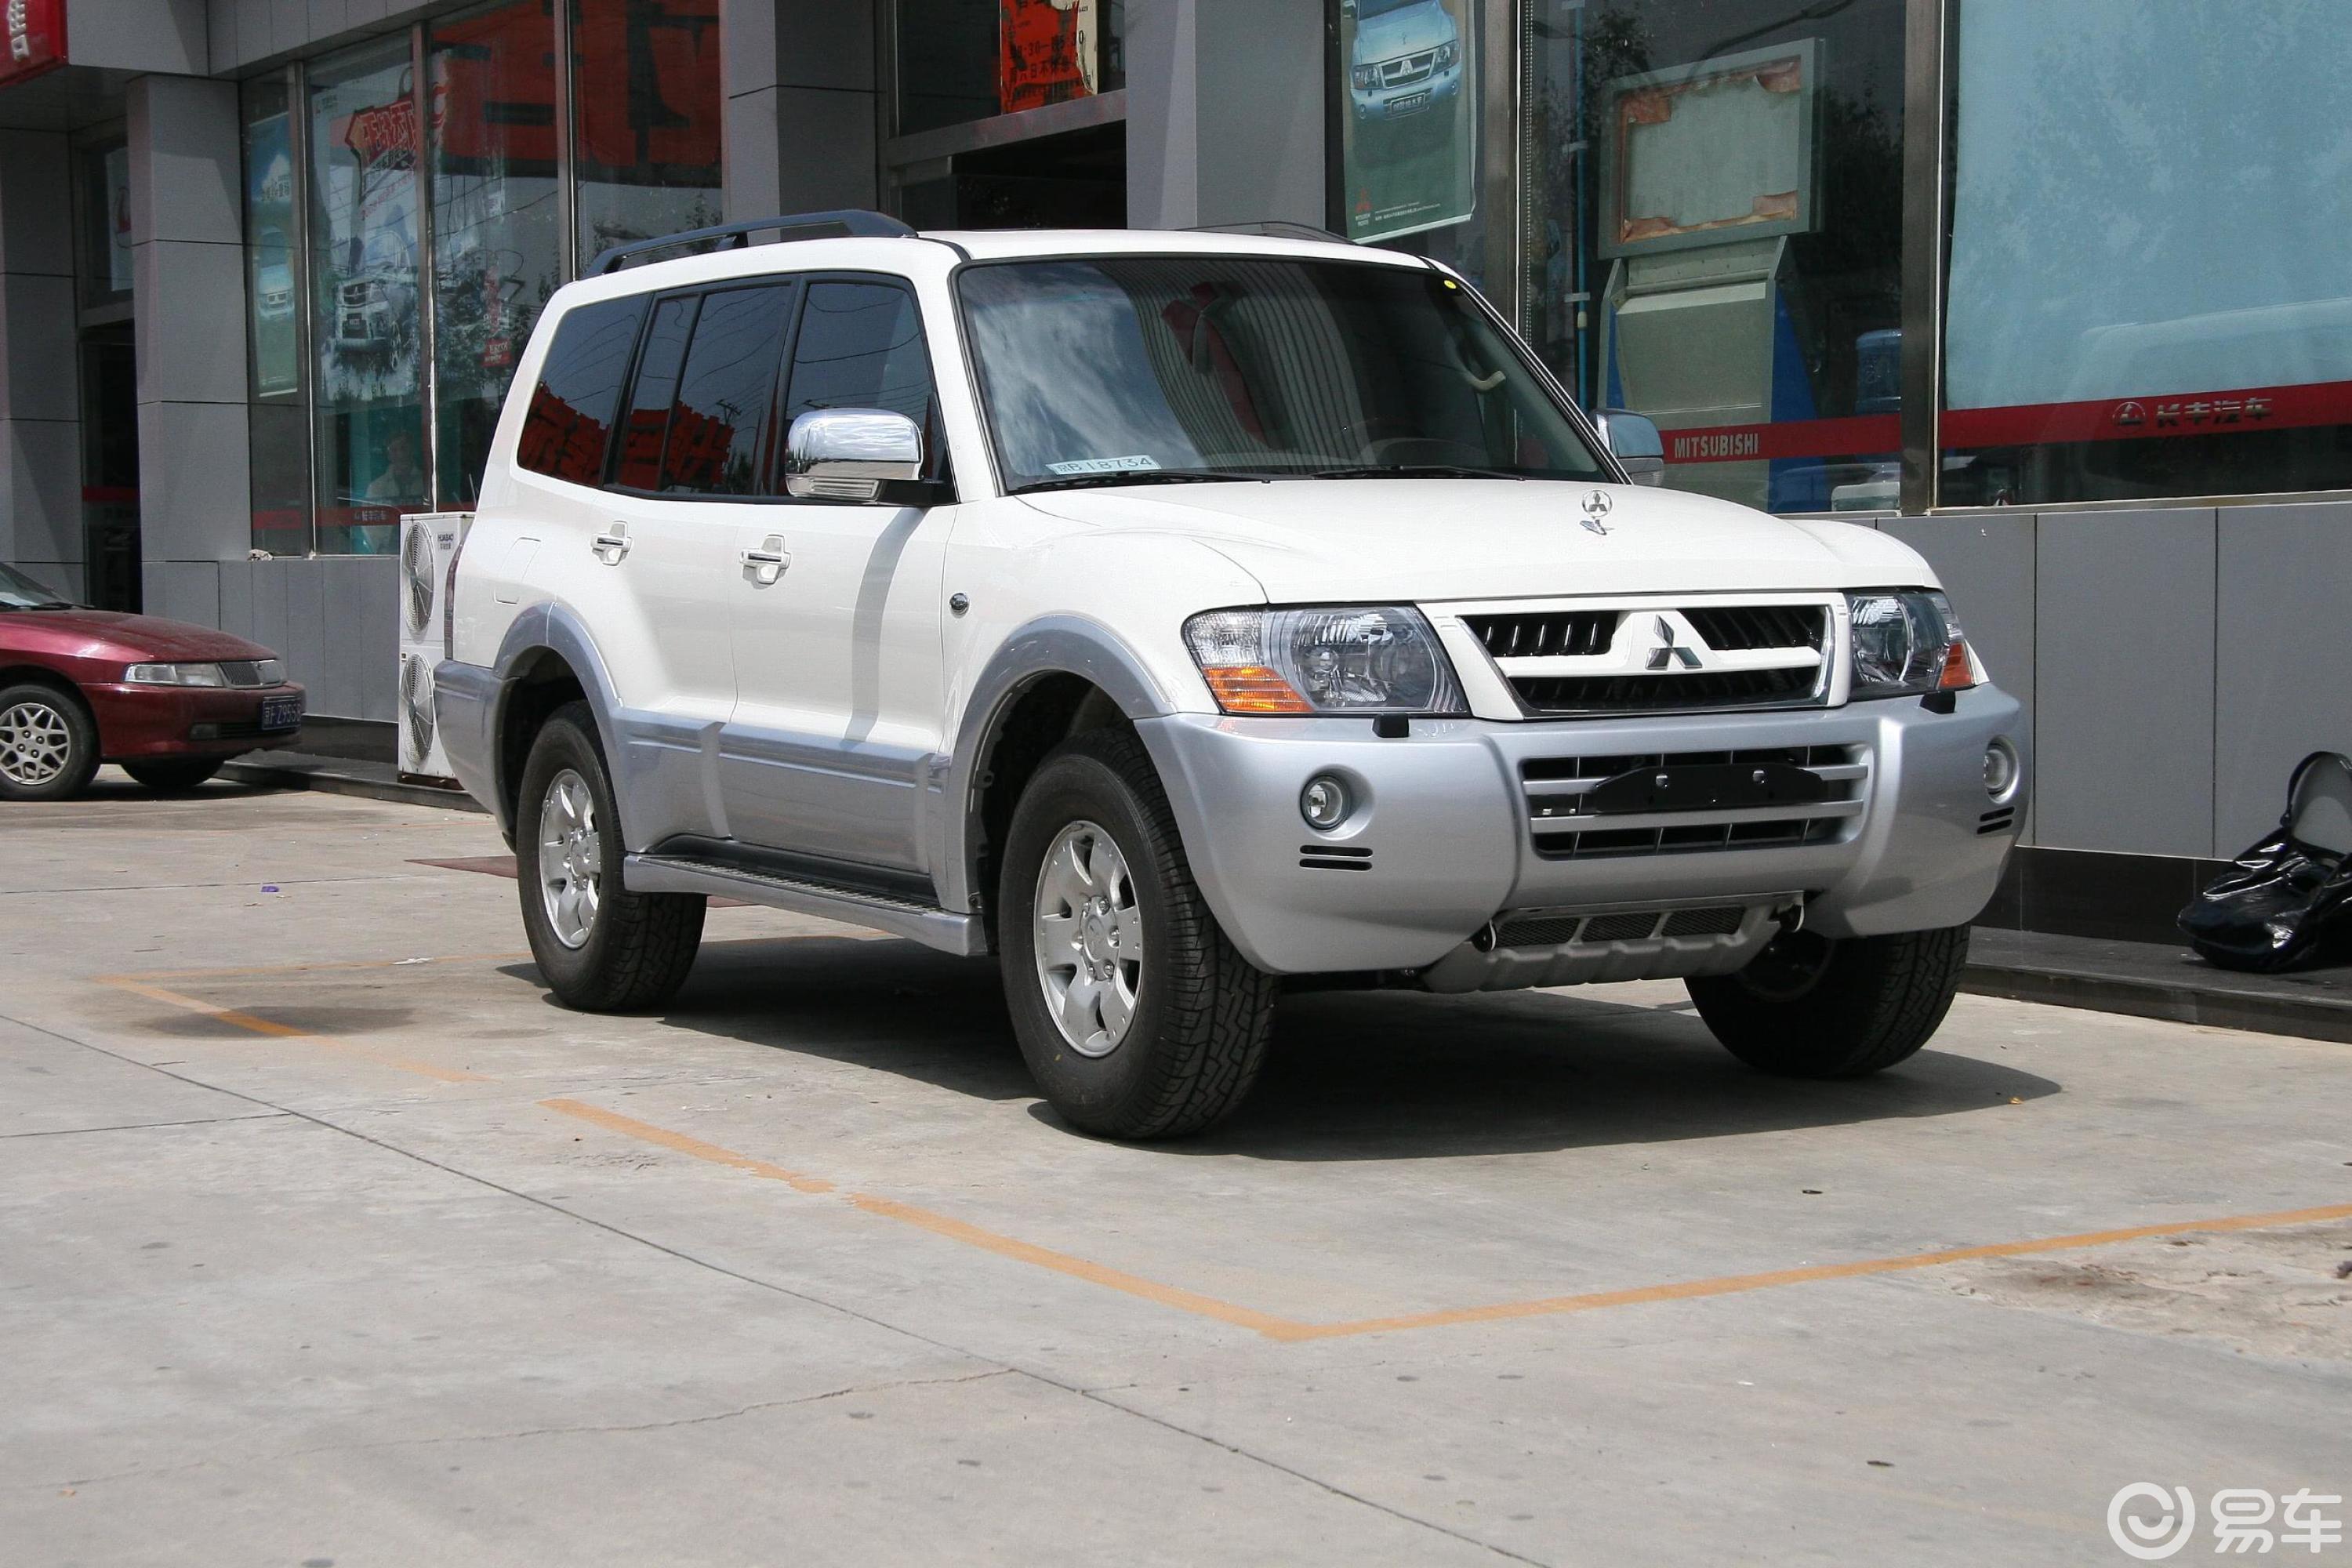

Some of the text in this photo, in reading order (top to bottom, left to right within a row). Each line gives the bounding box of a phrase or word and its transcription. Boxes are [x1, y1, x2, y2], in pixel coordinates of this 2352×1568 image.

[2157, 397, 2272, 427] 长丰汽车
[1675, 433, 1759, 459] MITSUBISHI
[437, 533, 454, 542] HUABAO
